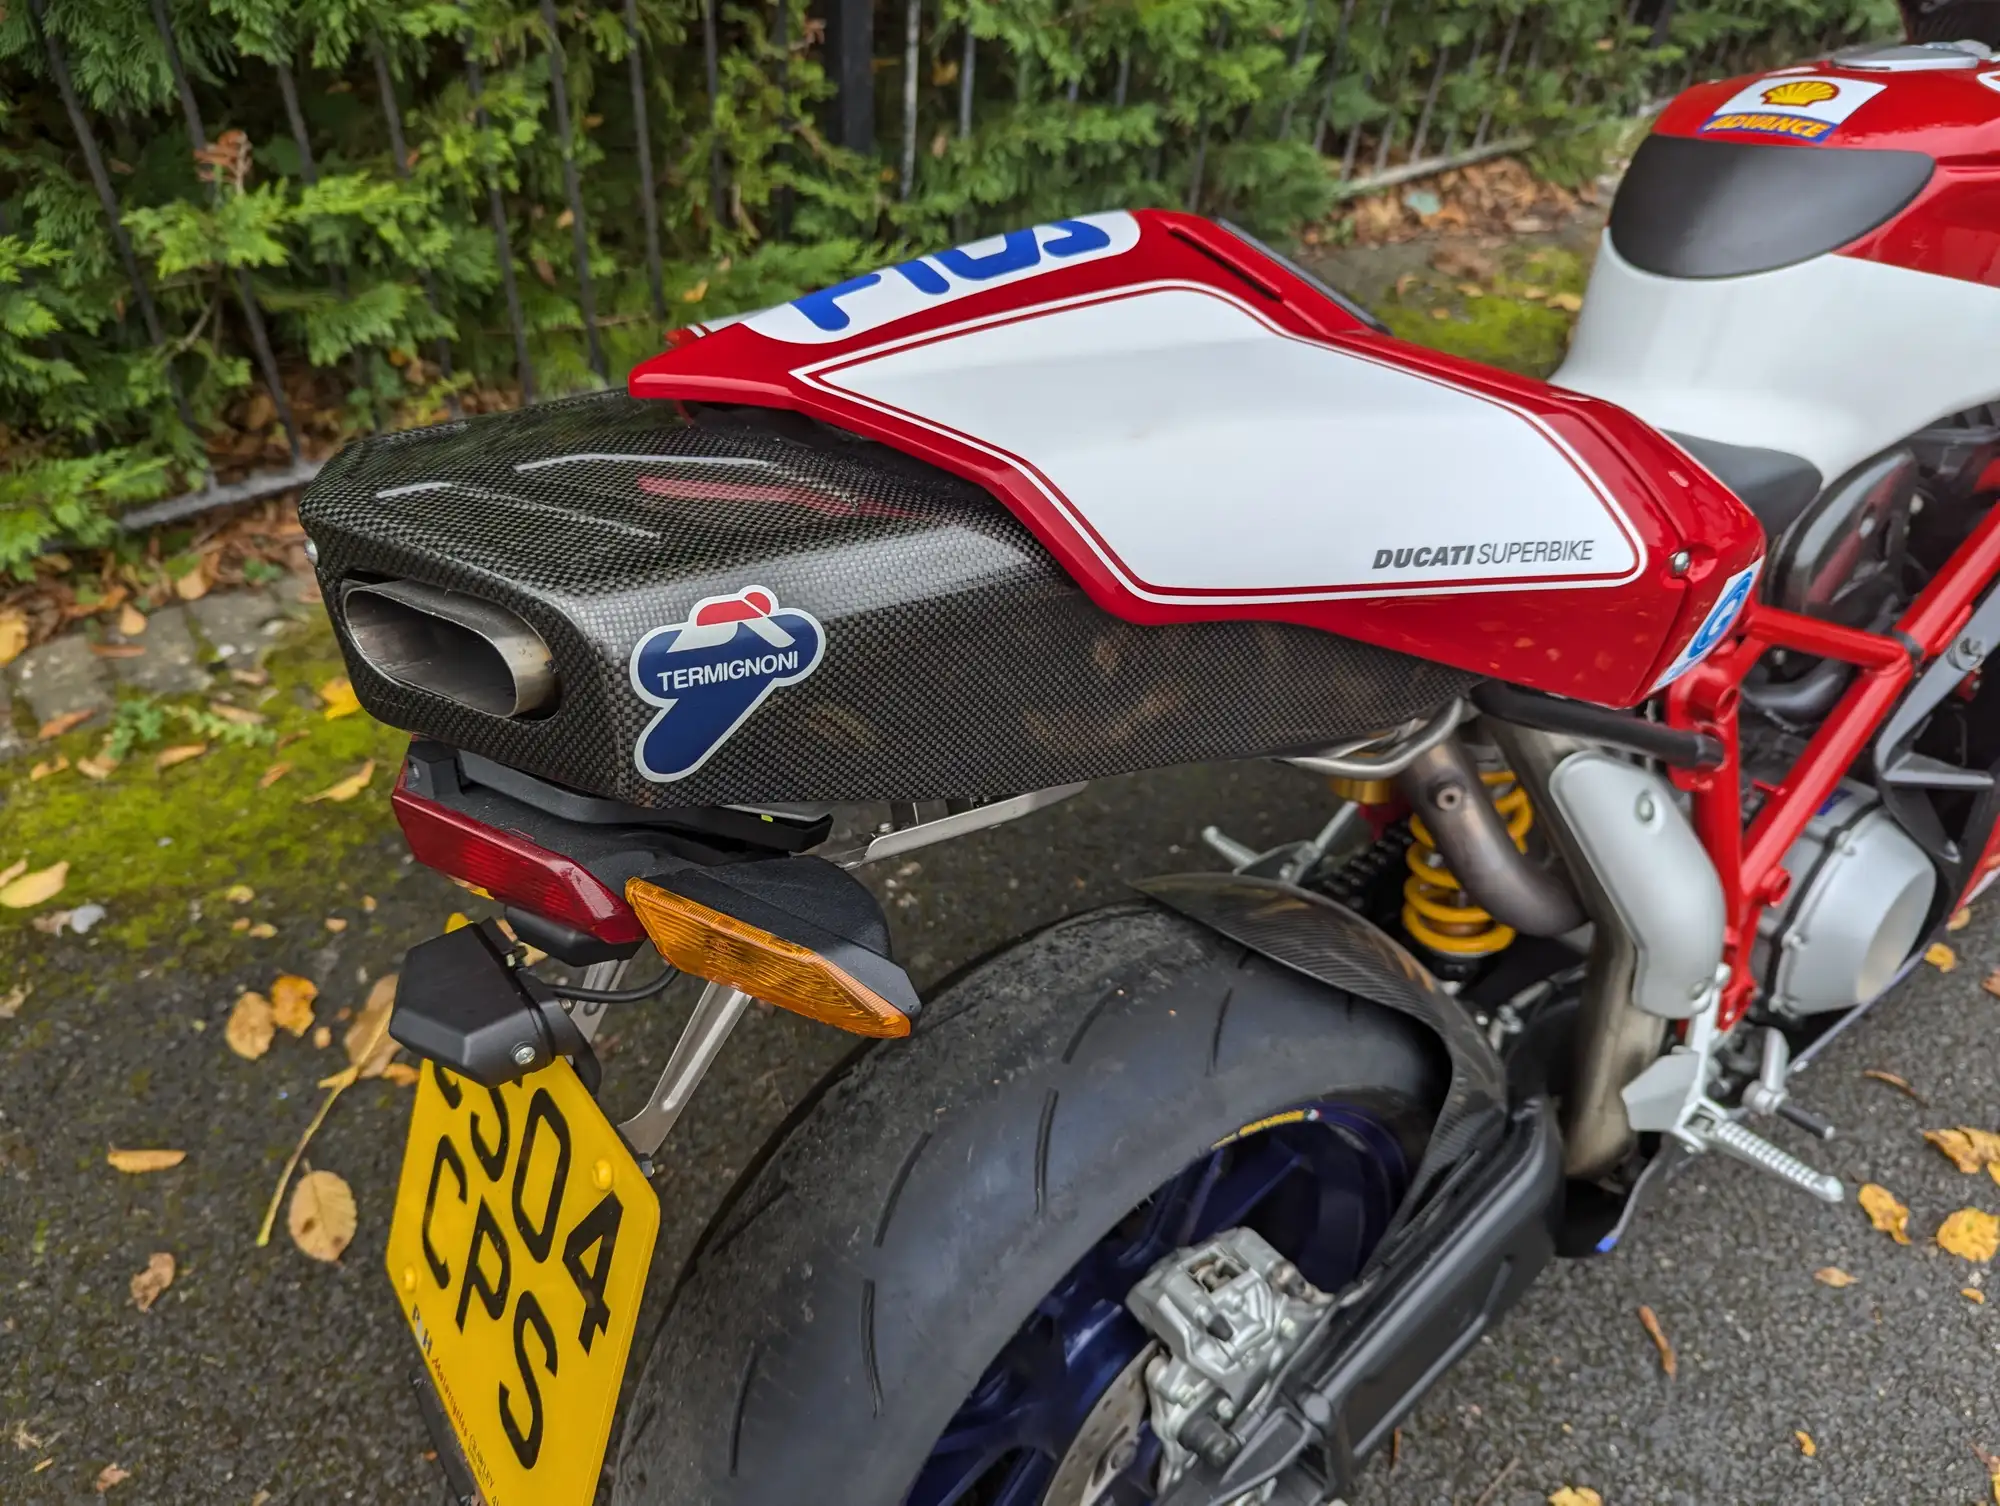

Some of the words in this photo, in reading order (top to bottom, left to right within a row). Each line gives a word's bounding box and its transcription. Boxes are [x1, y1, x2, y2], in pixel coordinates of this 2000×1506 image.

[1703, 114, 1831, 138] ADVANCE
[1371, 545, 1476, 570] DUCATI
[1476, 539, 1595, 565] SUPERBIKE
[657, 650, 799, 692] TERMIGNONI
[432, 1062, 624, 1357] S04
[421, 1134, 559, 1470] CPS
